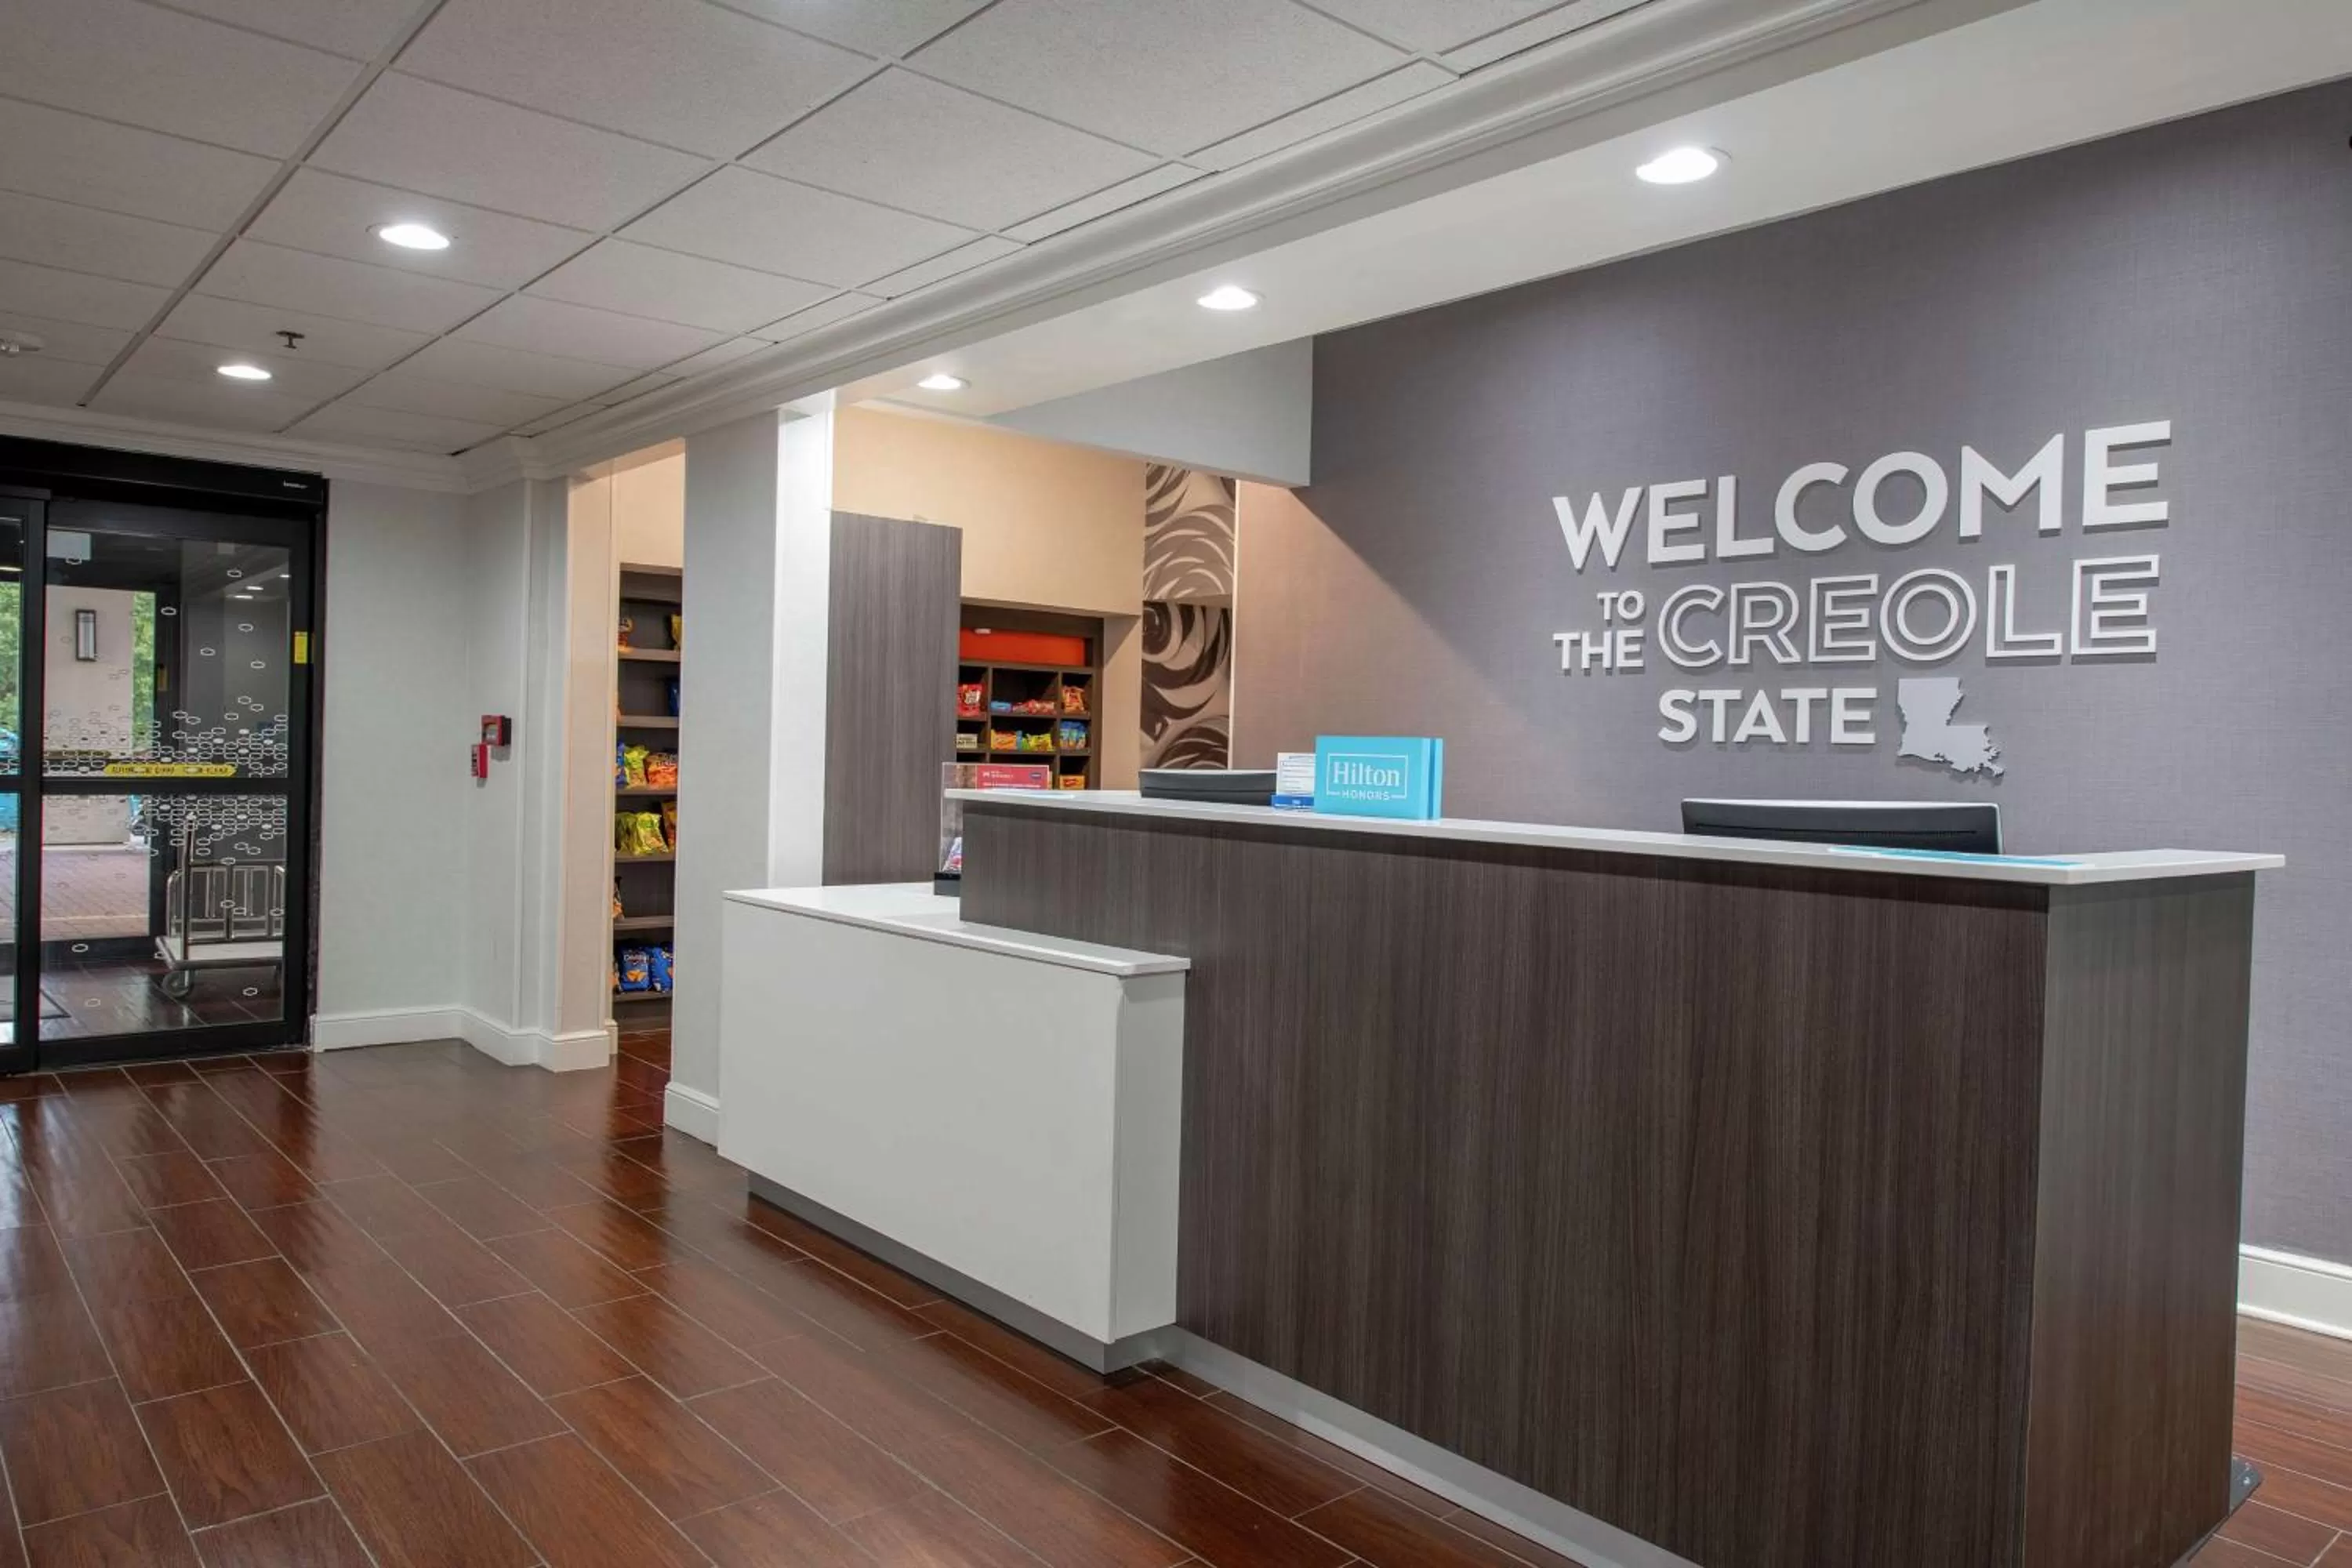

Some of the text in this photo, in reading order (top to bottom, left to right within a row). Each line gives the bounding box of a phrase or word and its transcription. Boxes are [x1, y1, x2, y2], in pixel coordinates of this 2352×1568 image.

[1552, 420, 2171, 571] WELCOME
[1553, 554, 2160, 670] THE CREOLE
[1596, 590, 1646, 621] TO
[1657, 688, 1878, 744] STATE
[1332, 760, 1400, 787] Hilton
[1341, 789, 1391, 800] HONORS
